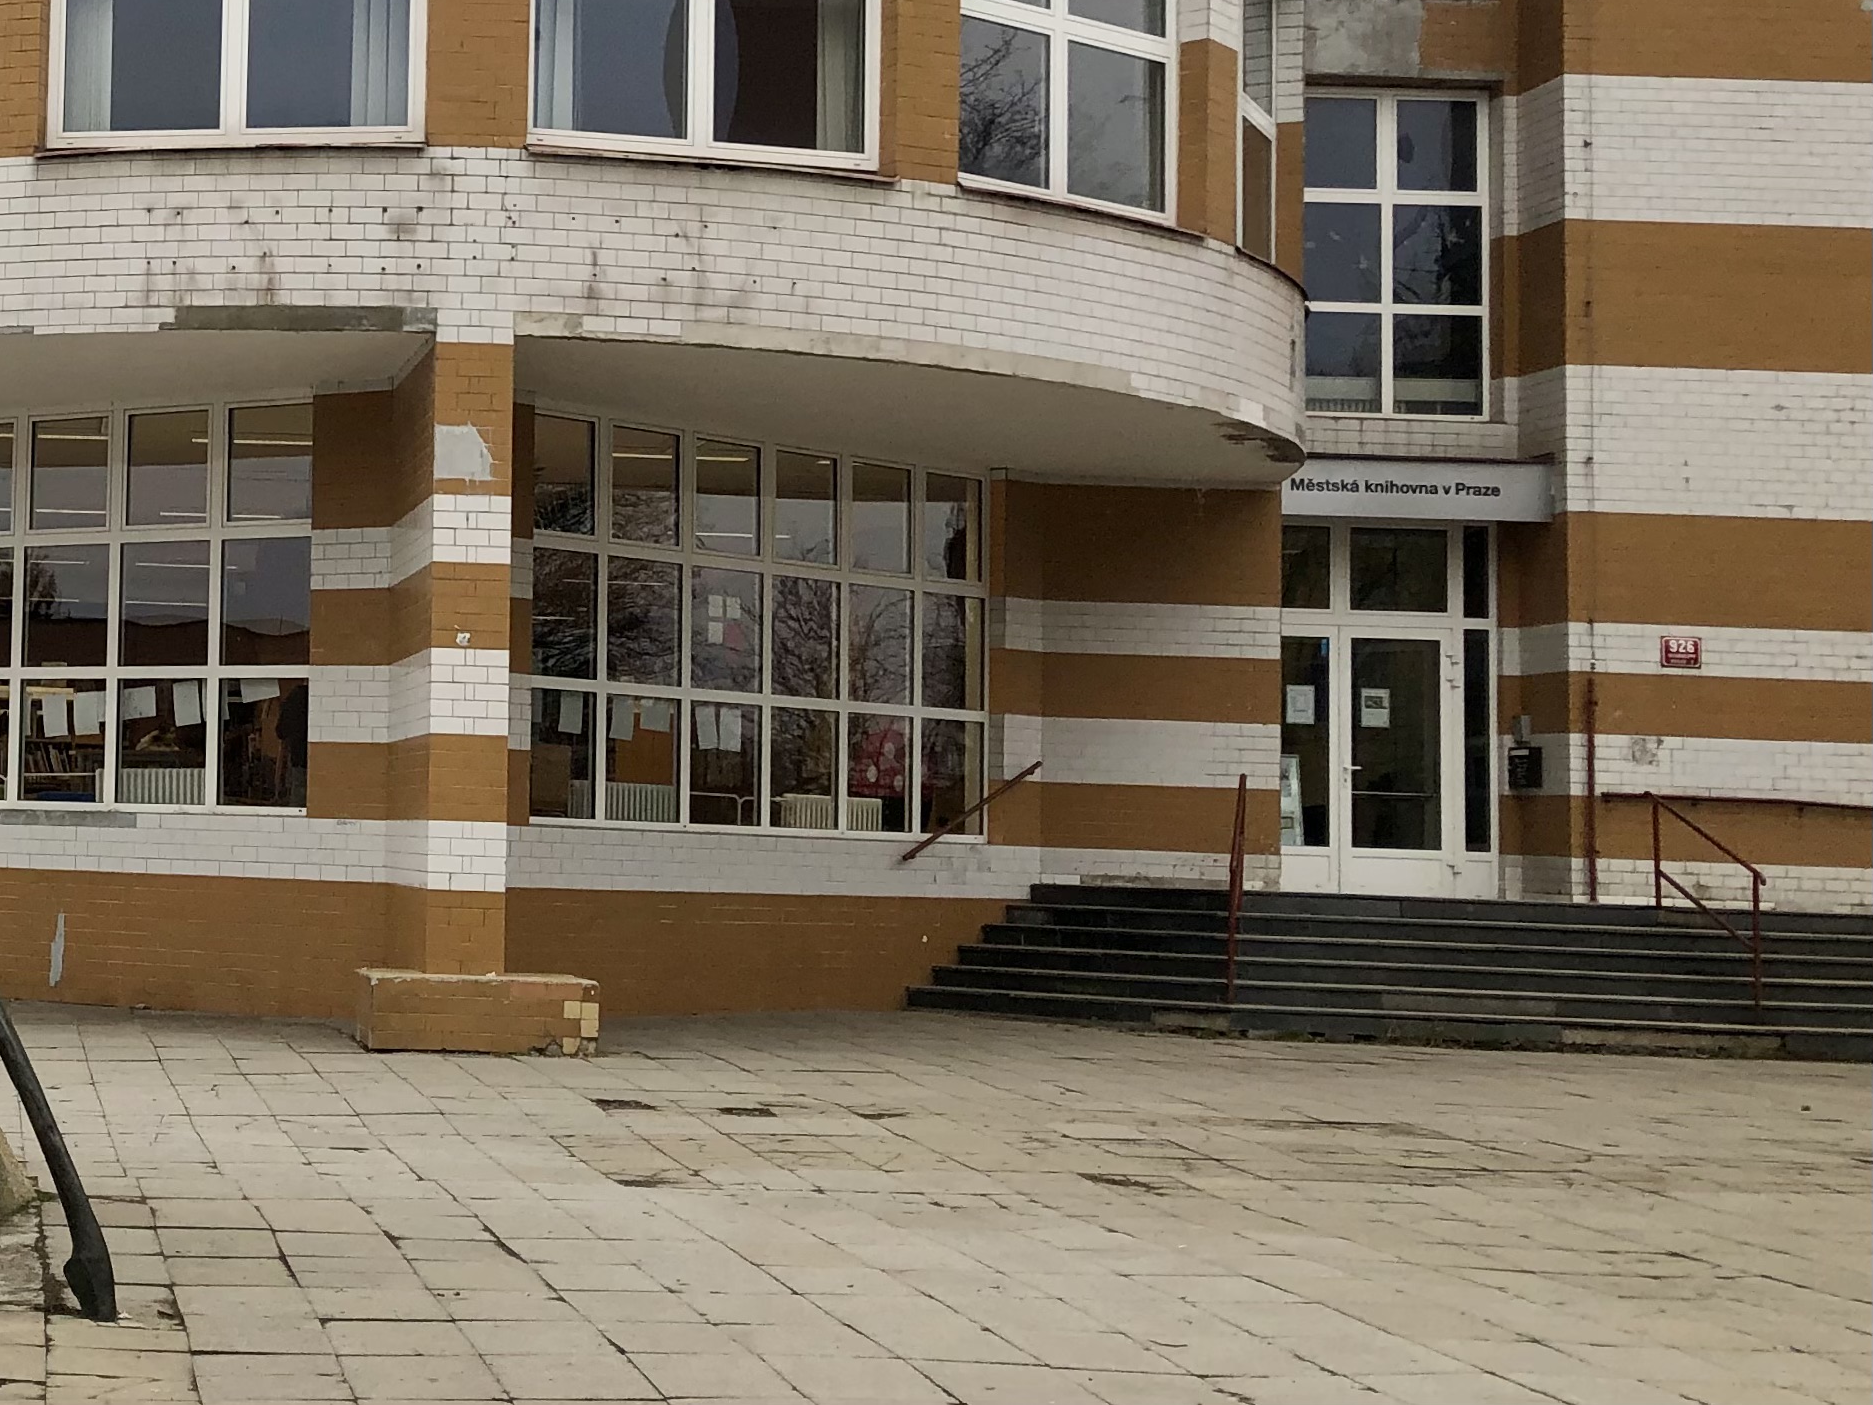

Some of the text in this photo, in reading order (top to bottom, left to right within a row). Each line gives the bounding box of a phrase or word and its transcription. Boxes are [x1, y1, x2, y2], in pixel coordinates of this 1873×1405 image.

[1290, 478, 1501, 497] Městská knihovna v Praze
[1669, 640, 1695, 653] 926
